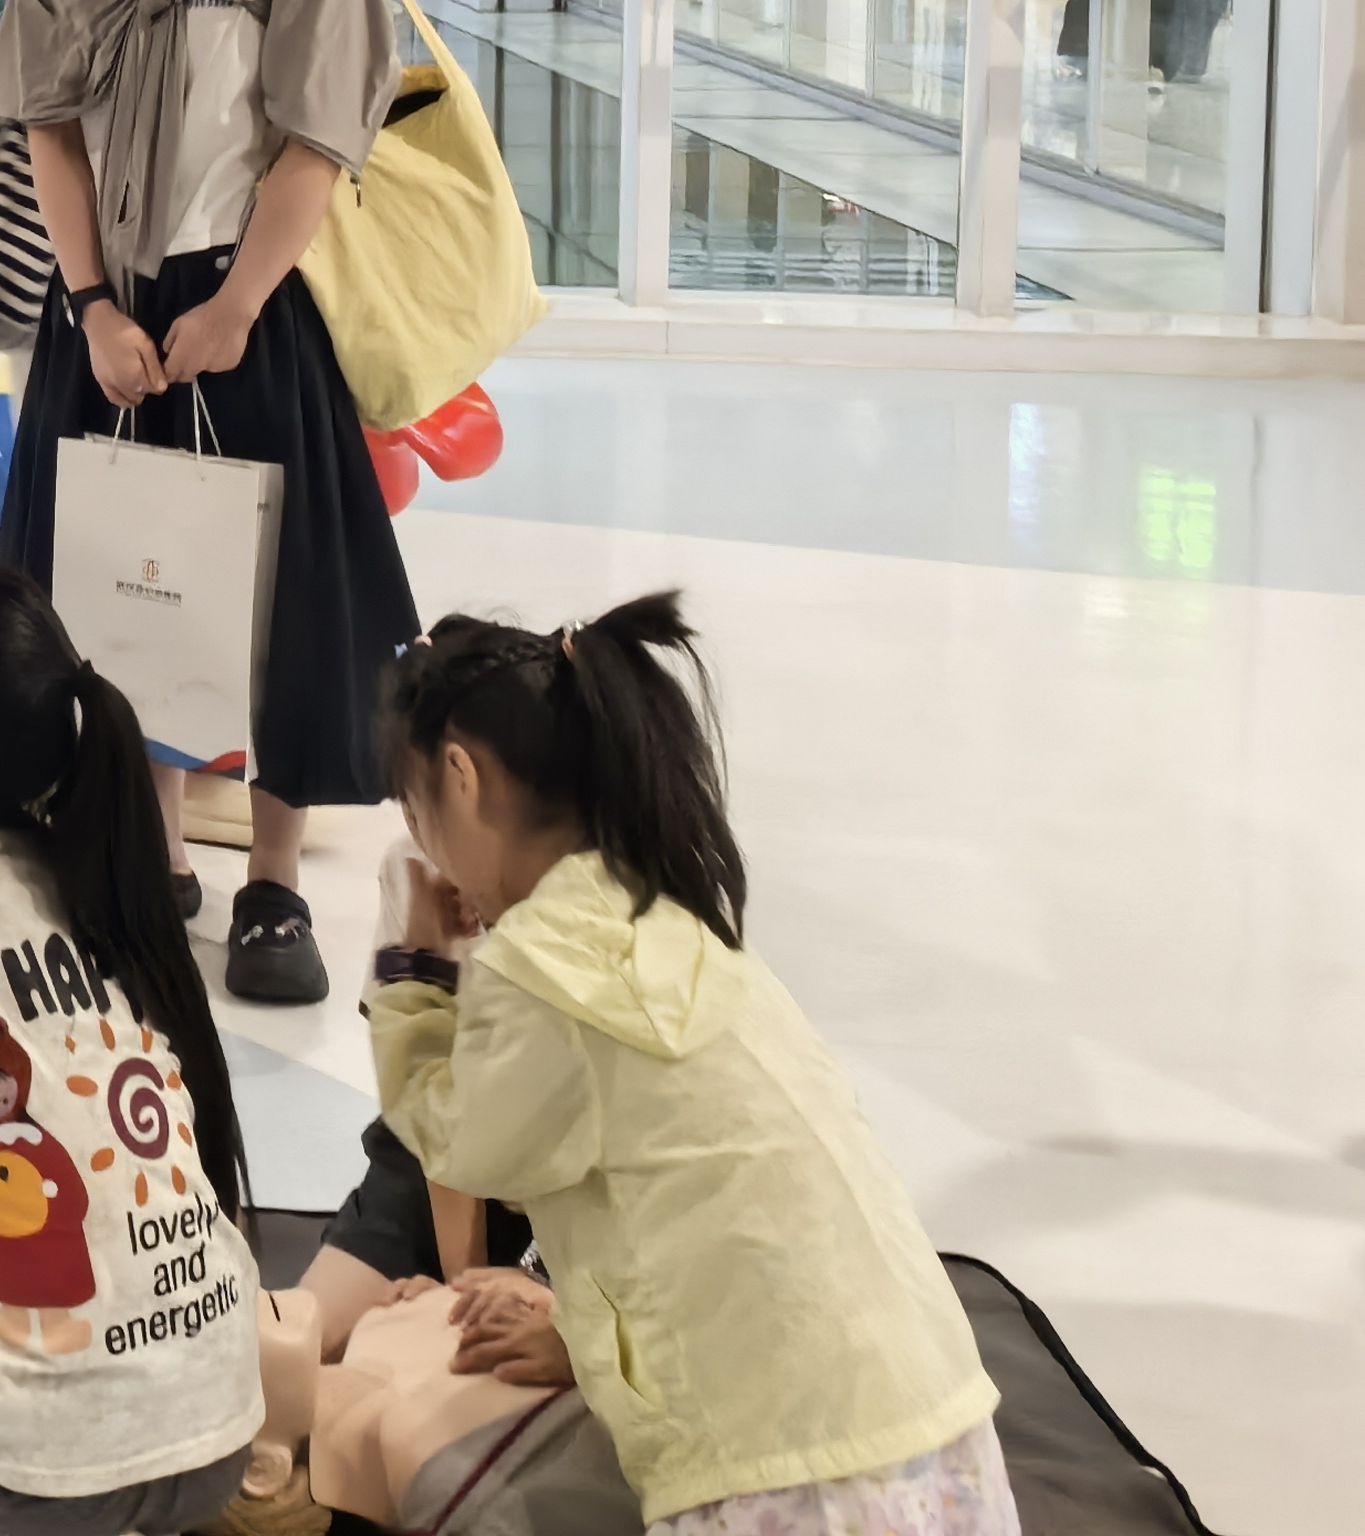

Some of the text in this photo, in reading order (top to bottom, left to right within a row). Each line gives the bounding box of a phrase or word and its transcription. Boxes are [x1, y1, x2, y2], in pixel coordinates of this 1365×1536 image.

[127, 1192, 219, 1257] lovely
[153, 1241, 206, 1297] and
[105, 1272, 239, 1356] energetic
